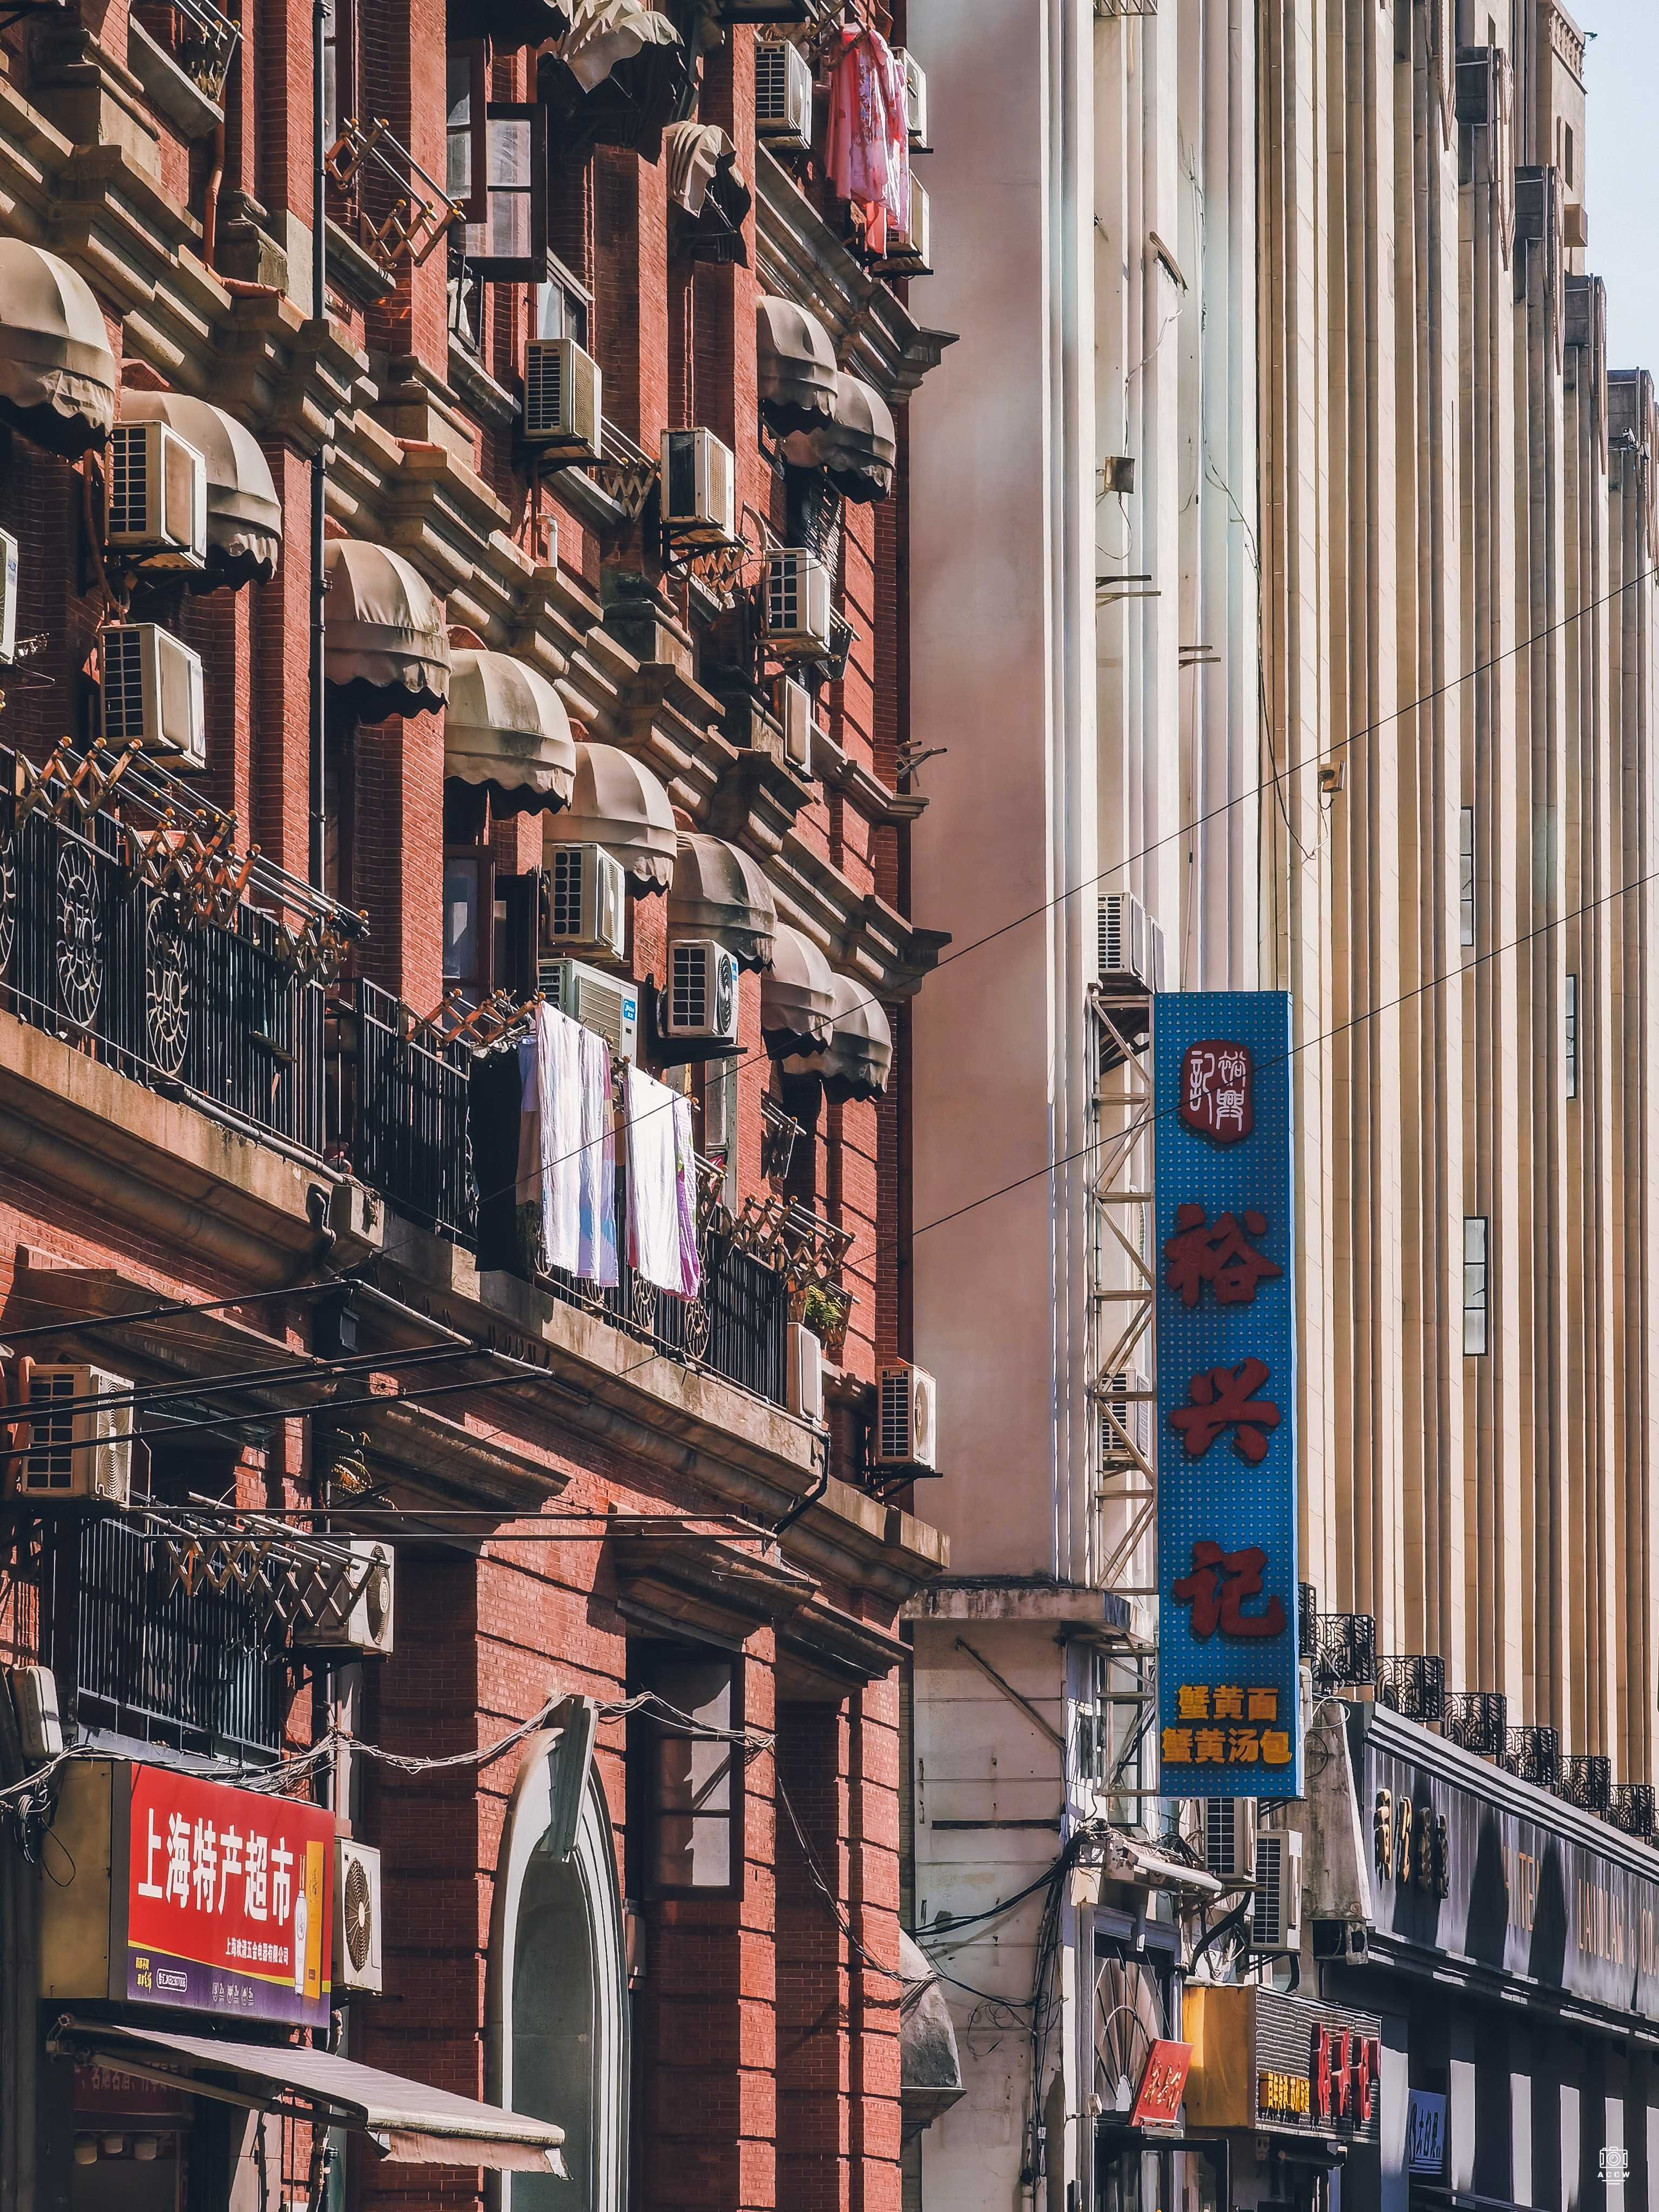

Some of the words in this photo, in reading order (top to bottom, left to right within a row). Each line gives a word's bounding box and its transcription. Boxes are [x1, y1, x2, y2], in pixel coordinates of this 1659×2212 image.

[1165, 1203, 1287, 1637] 裕兴记
[1178, 1684, 1279, 1722] 蟹黄面
[1161, 1726, 1293, 1764] 蟹黄汤包
[138, 1808, 294, 1926] 上海特产超市
